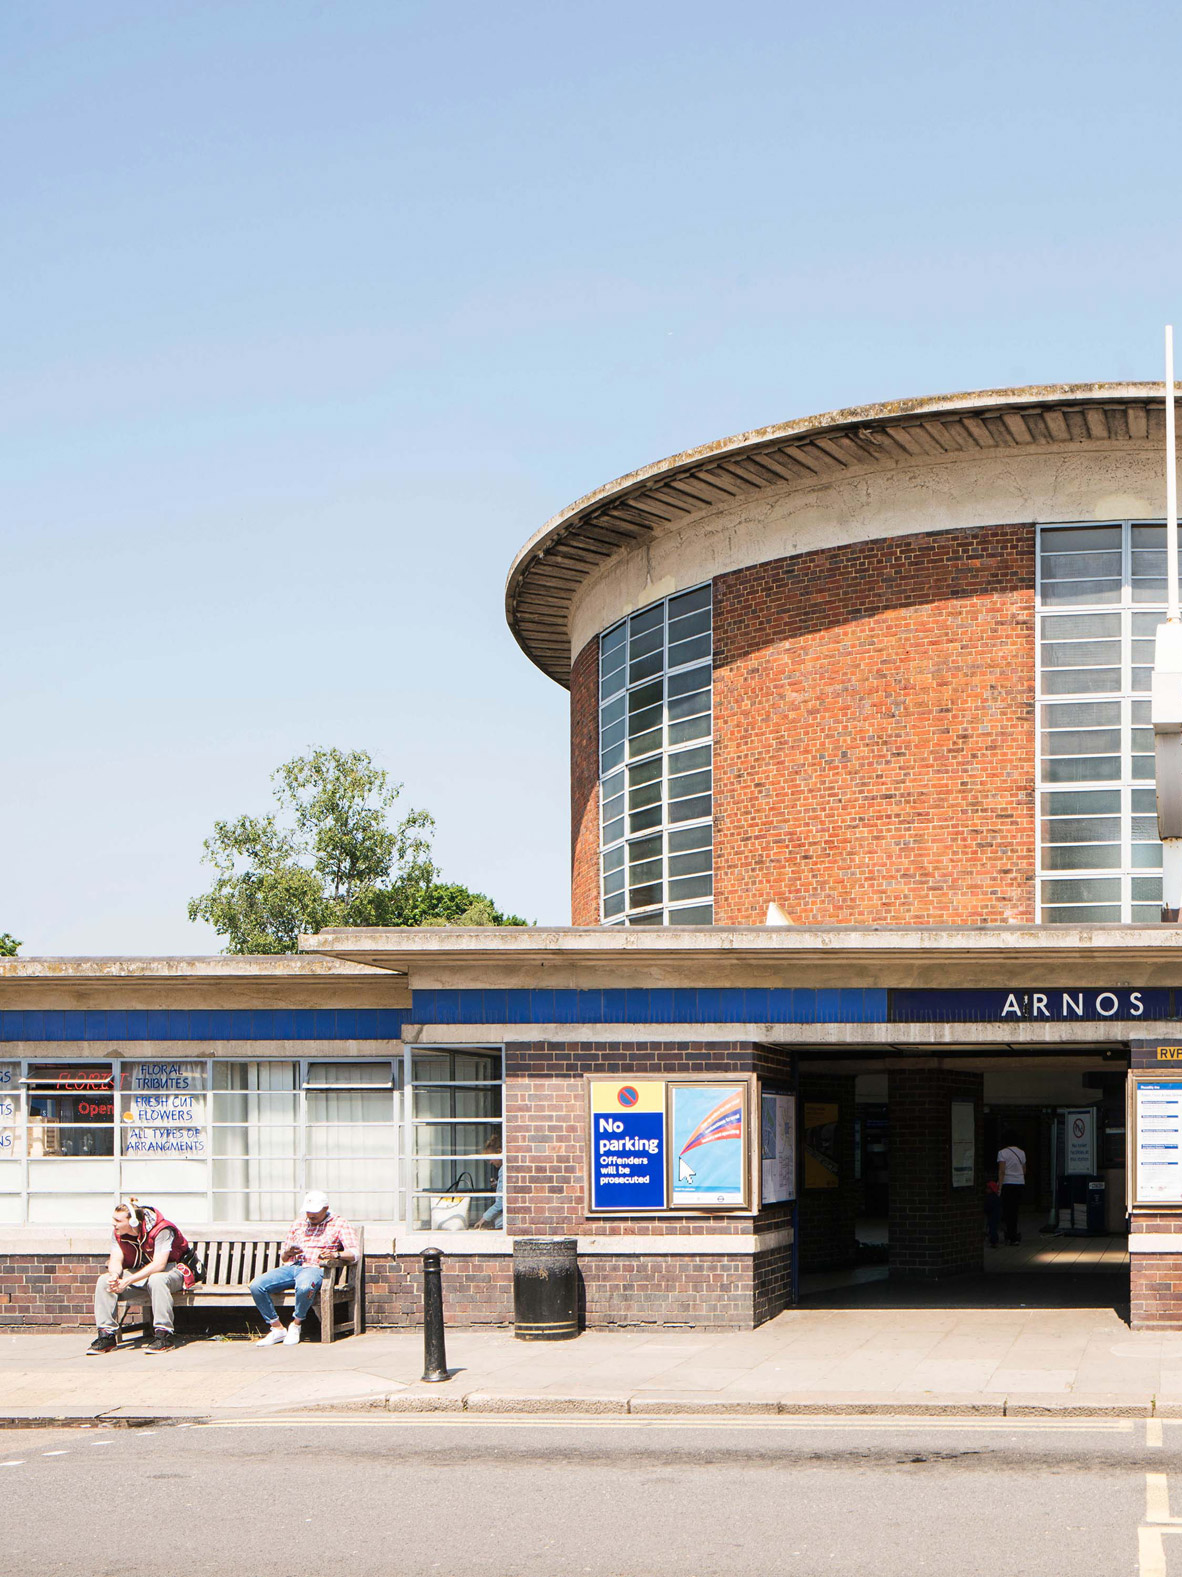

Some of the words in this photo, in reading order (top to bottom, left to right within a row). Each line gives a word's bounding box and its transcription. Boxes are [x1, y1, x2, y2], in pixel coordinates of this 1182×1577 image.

[1001, 992, 1144, 1016] ARNOS
[140, 1064, 184, 1076] FLORAL
[136, 1078, 189, 1089] TRIBUTES
[136, 1096, 168, 1108] FRESH
[172, 1096, 194, 1107] CUT
[78, 1102, 114, 1117] Open
[138, 1109, 193, 1121] FLOWERS
[599, 1118, 624, 1133] No
[130, 1128, 148, 1140] ALL
[153, 1128, 184, 1139] TYPES
[186, 1128, 200, 1138] OF
[126, 1140, 204, 1152] ARRANGMENTS
[599, 1136, 659, 1154] parking
[600, 1156, 648, 1165] Offenders
[600, 1166, 616, 1174] will
[618, 1166, 630, 1174] be
[600, 1175, 650, 1185] prosecuted
